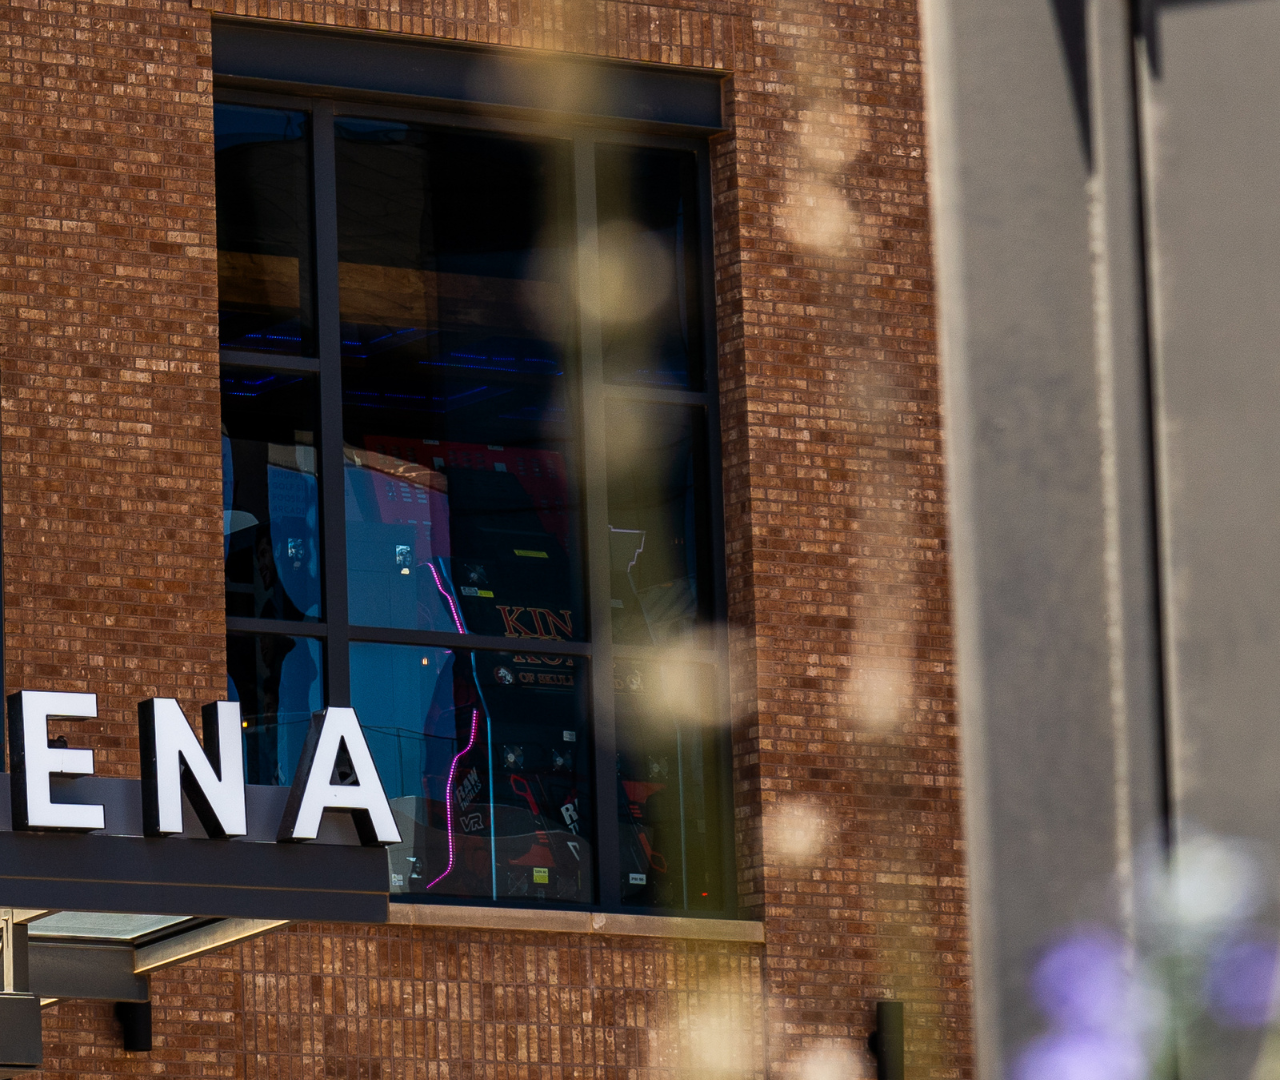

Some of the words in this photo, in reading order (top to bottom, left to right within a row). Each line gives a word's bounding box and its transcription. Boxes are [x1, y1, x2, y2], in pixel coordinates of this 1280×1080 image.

[495, 604, 573, 640] KIN
[455, 766, 481, 804] RAW
[459, 812, 485, 833] VR
